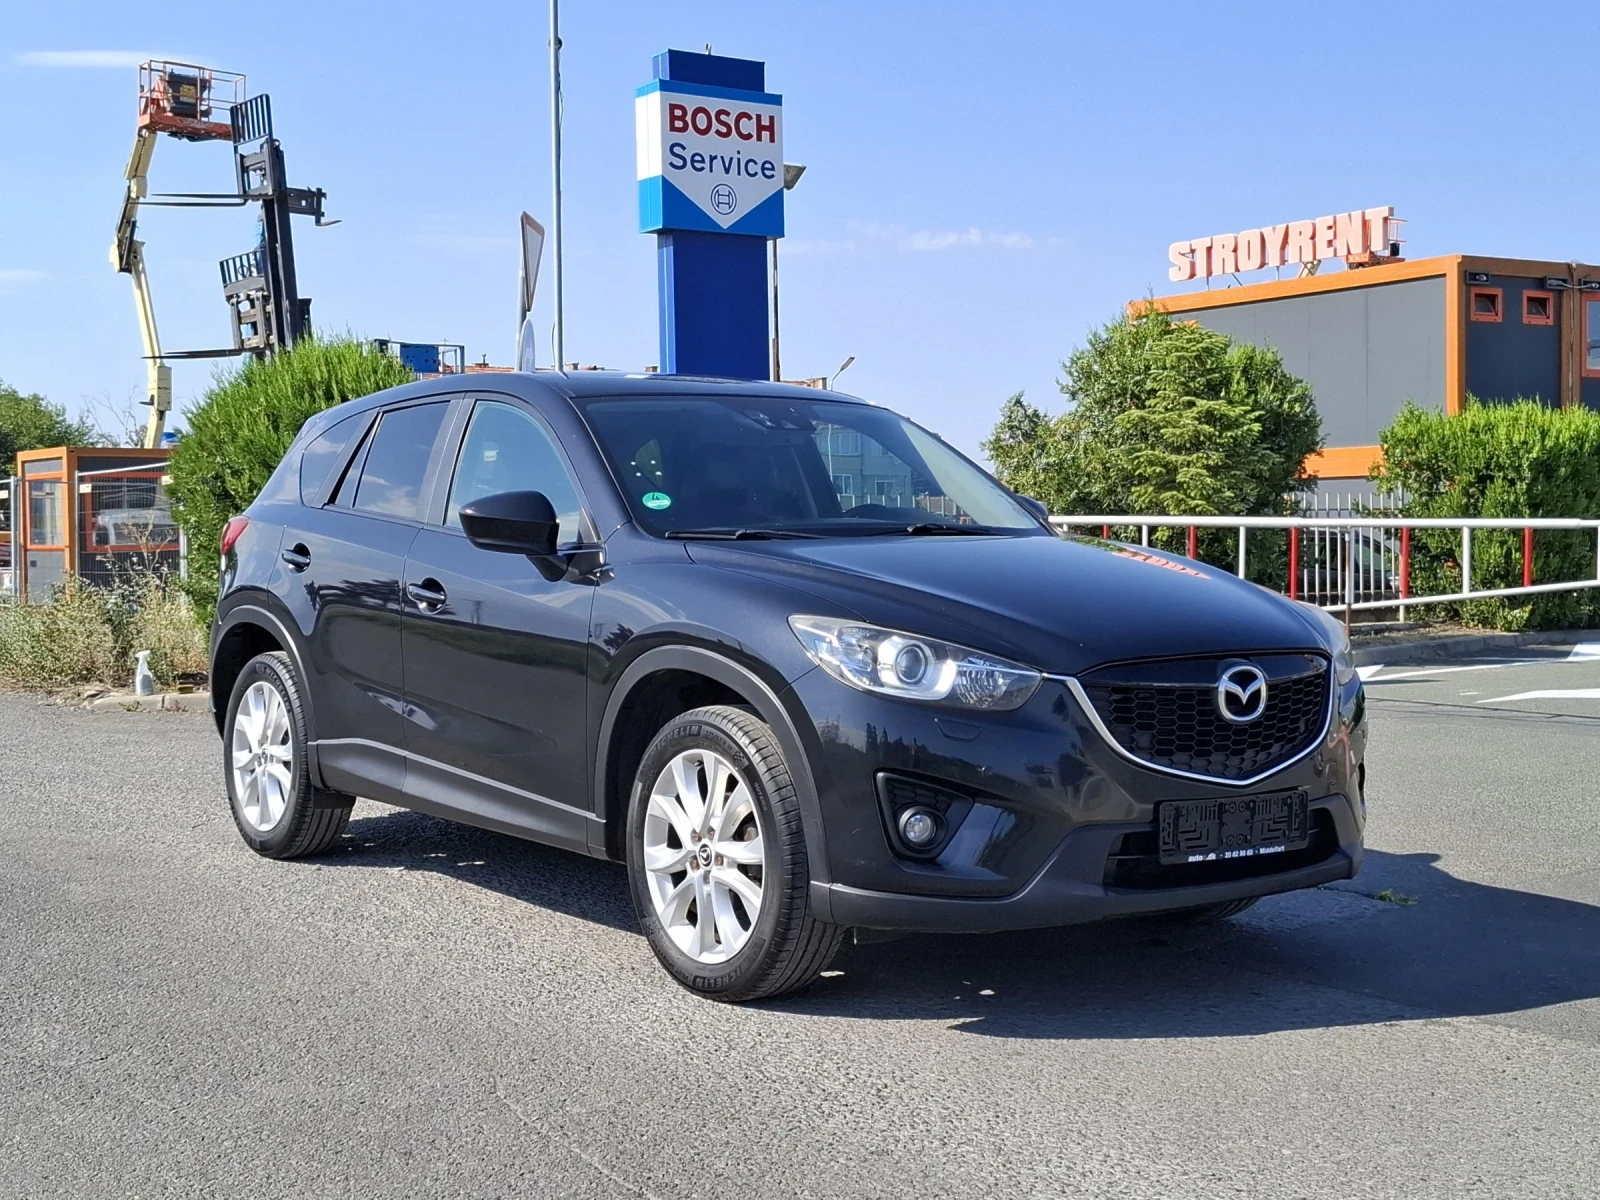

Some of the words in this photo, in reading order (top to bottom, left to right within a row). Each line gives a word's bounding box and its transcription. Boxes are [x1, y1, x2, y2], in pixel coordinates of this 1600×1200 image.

[668, 103, 776, 144] BOSCH
[668, 142, 776, 180] Service
[1169, 205, 1394, 282] STROYRENT
